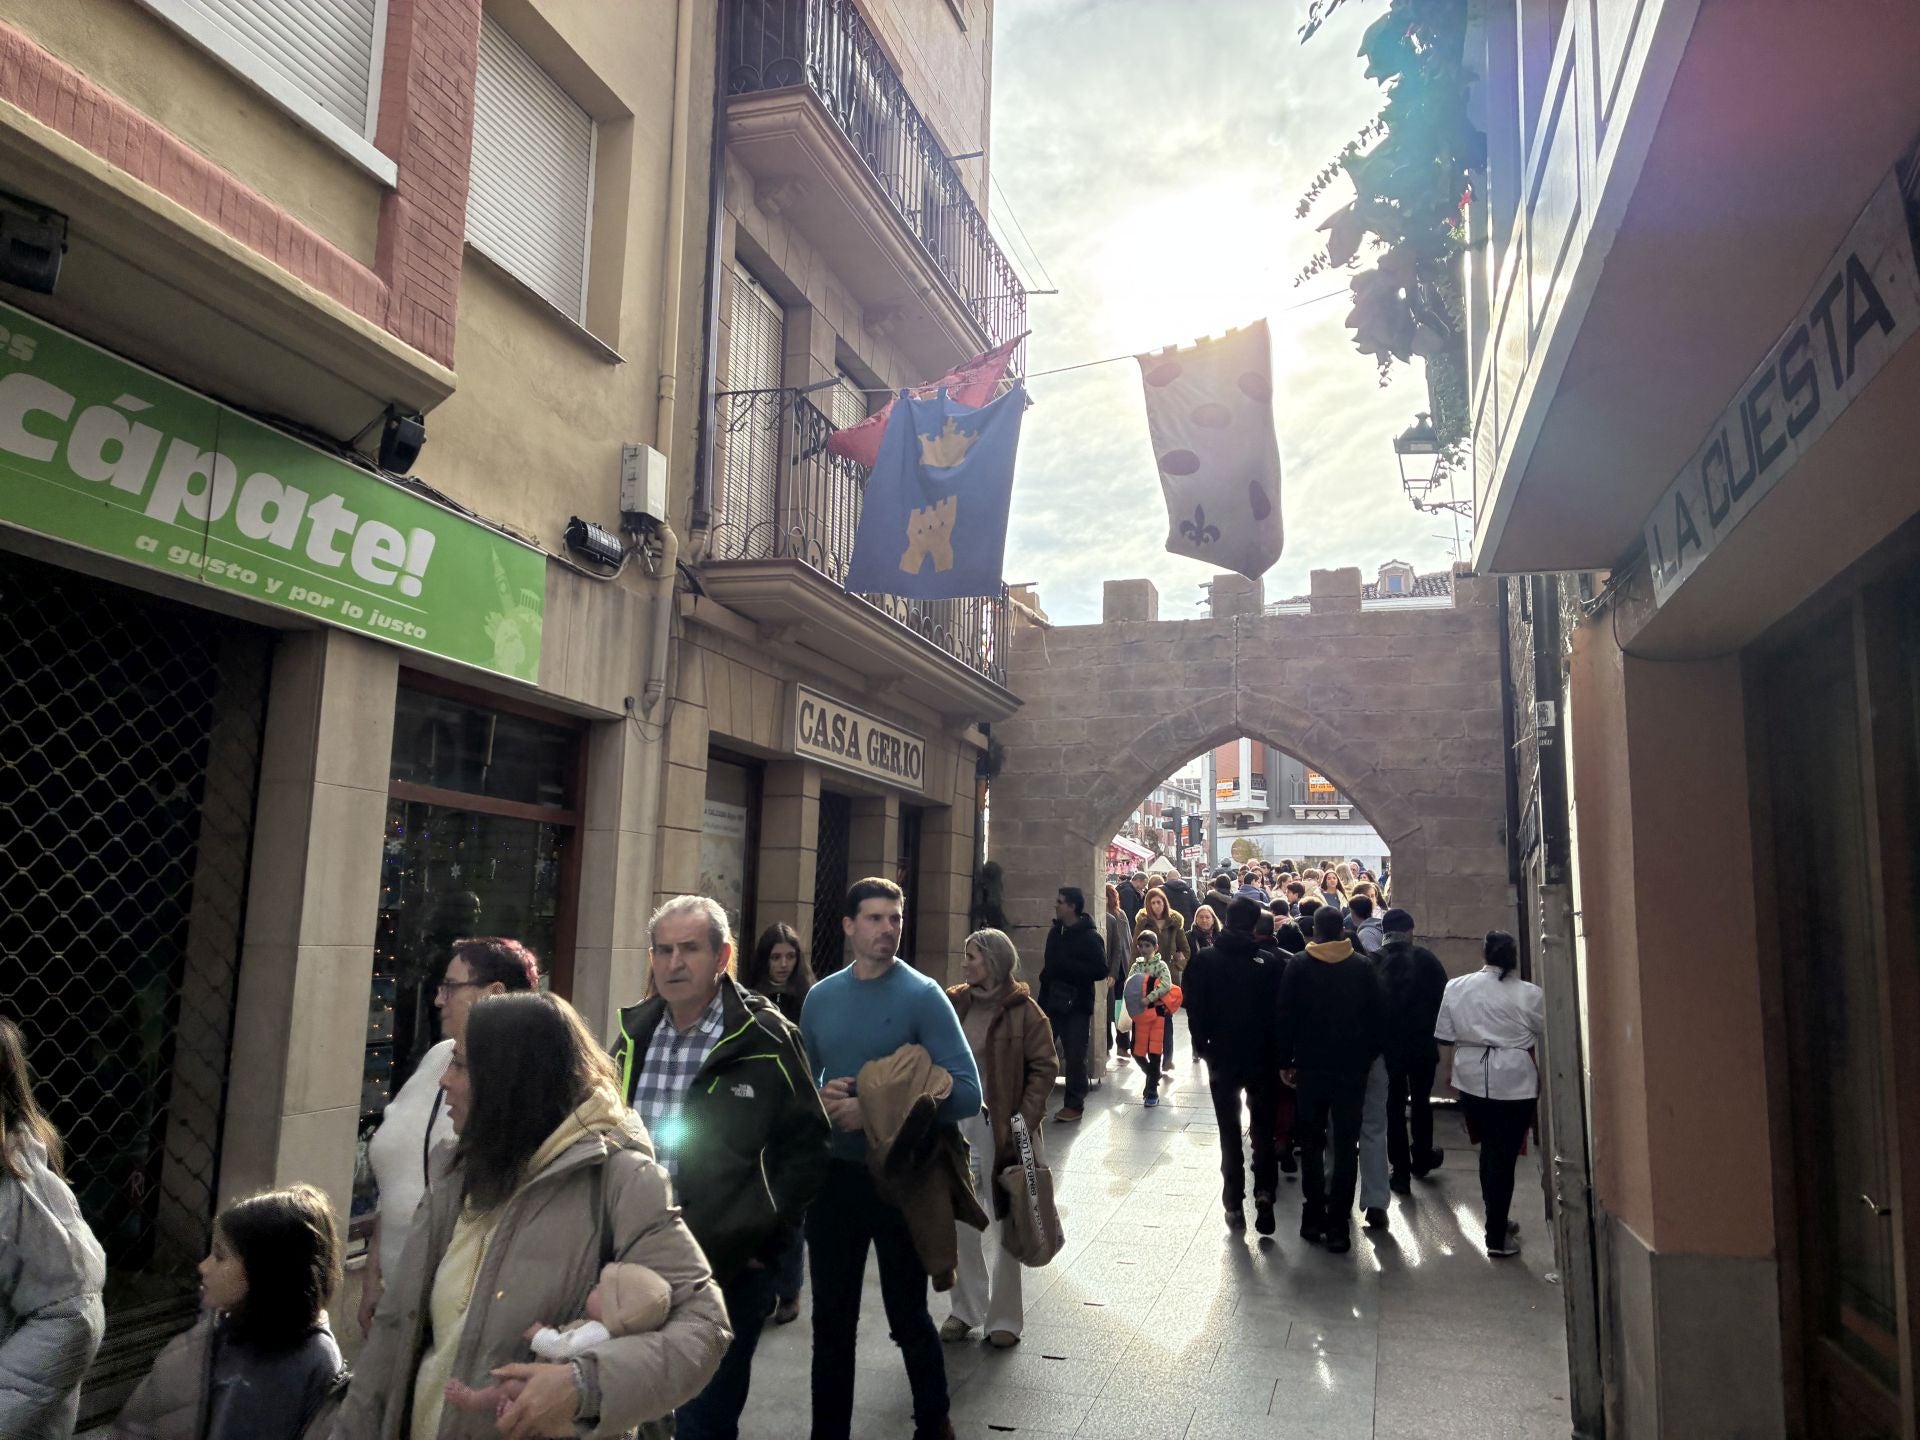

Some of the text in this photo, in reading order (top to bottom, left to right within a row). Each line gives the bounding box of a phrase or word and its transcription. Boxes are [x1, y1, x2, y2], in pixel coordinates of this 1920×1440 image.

[1653, 252, 1897, 580] LA CUESTA
[135, 535, 427, 640] a gusto y por lo justo
[799, 700, 922, 780] CASA GERIO
